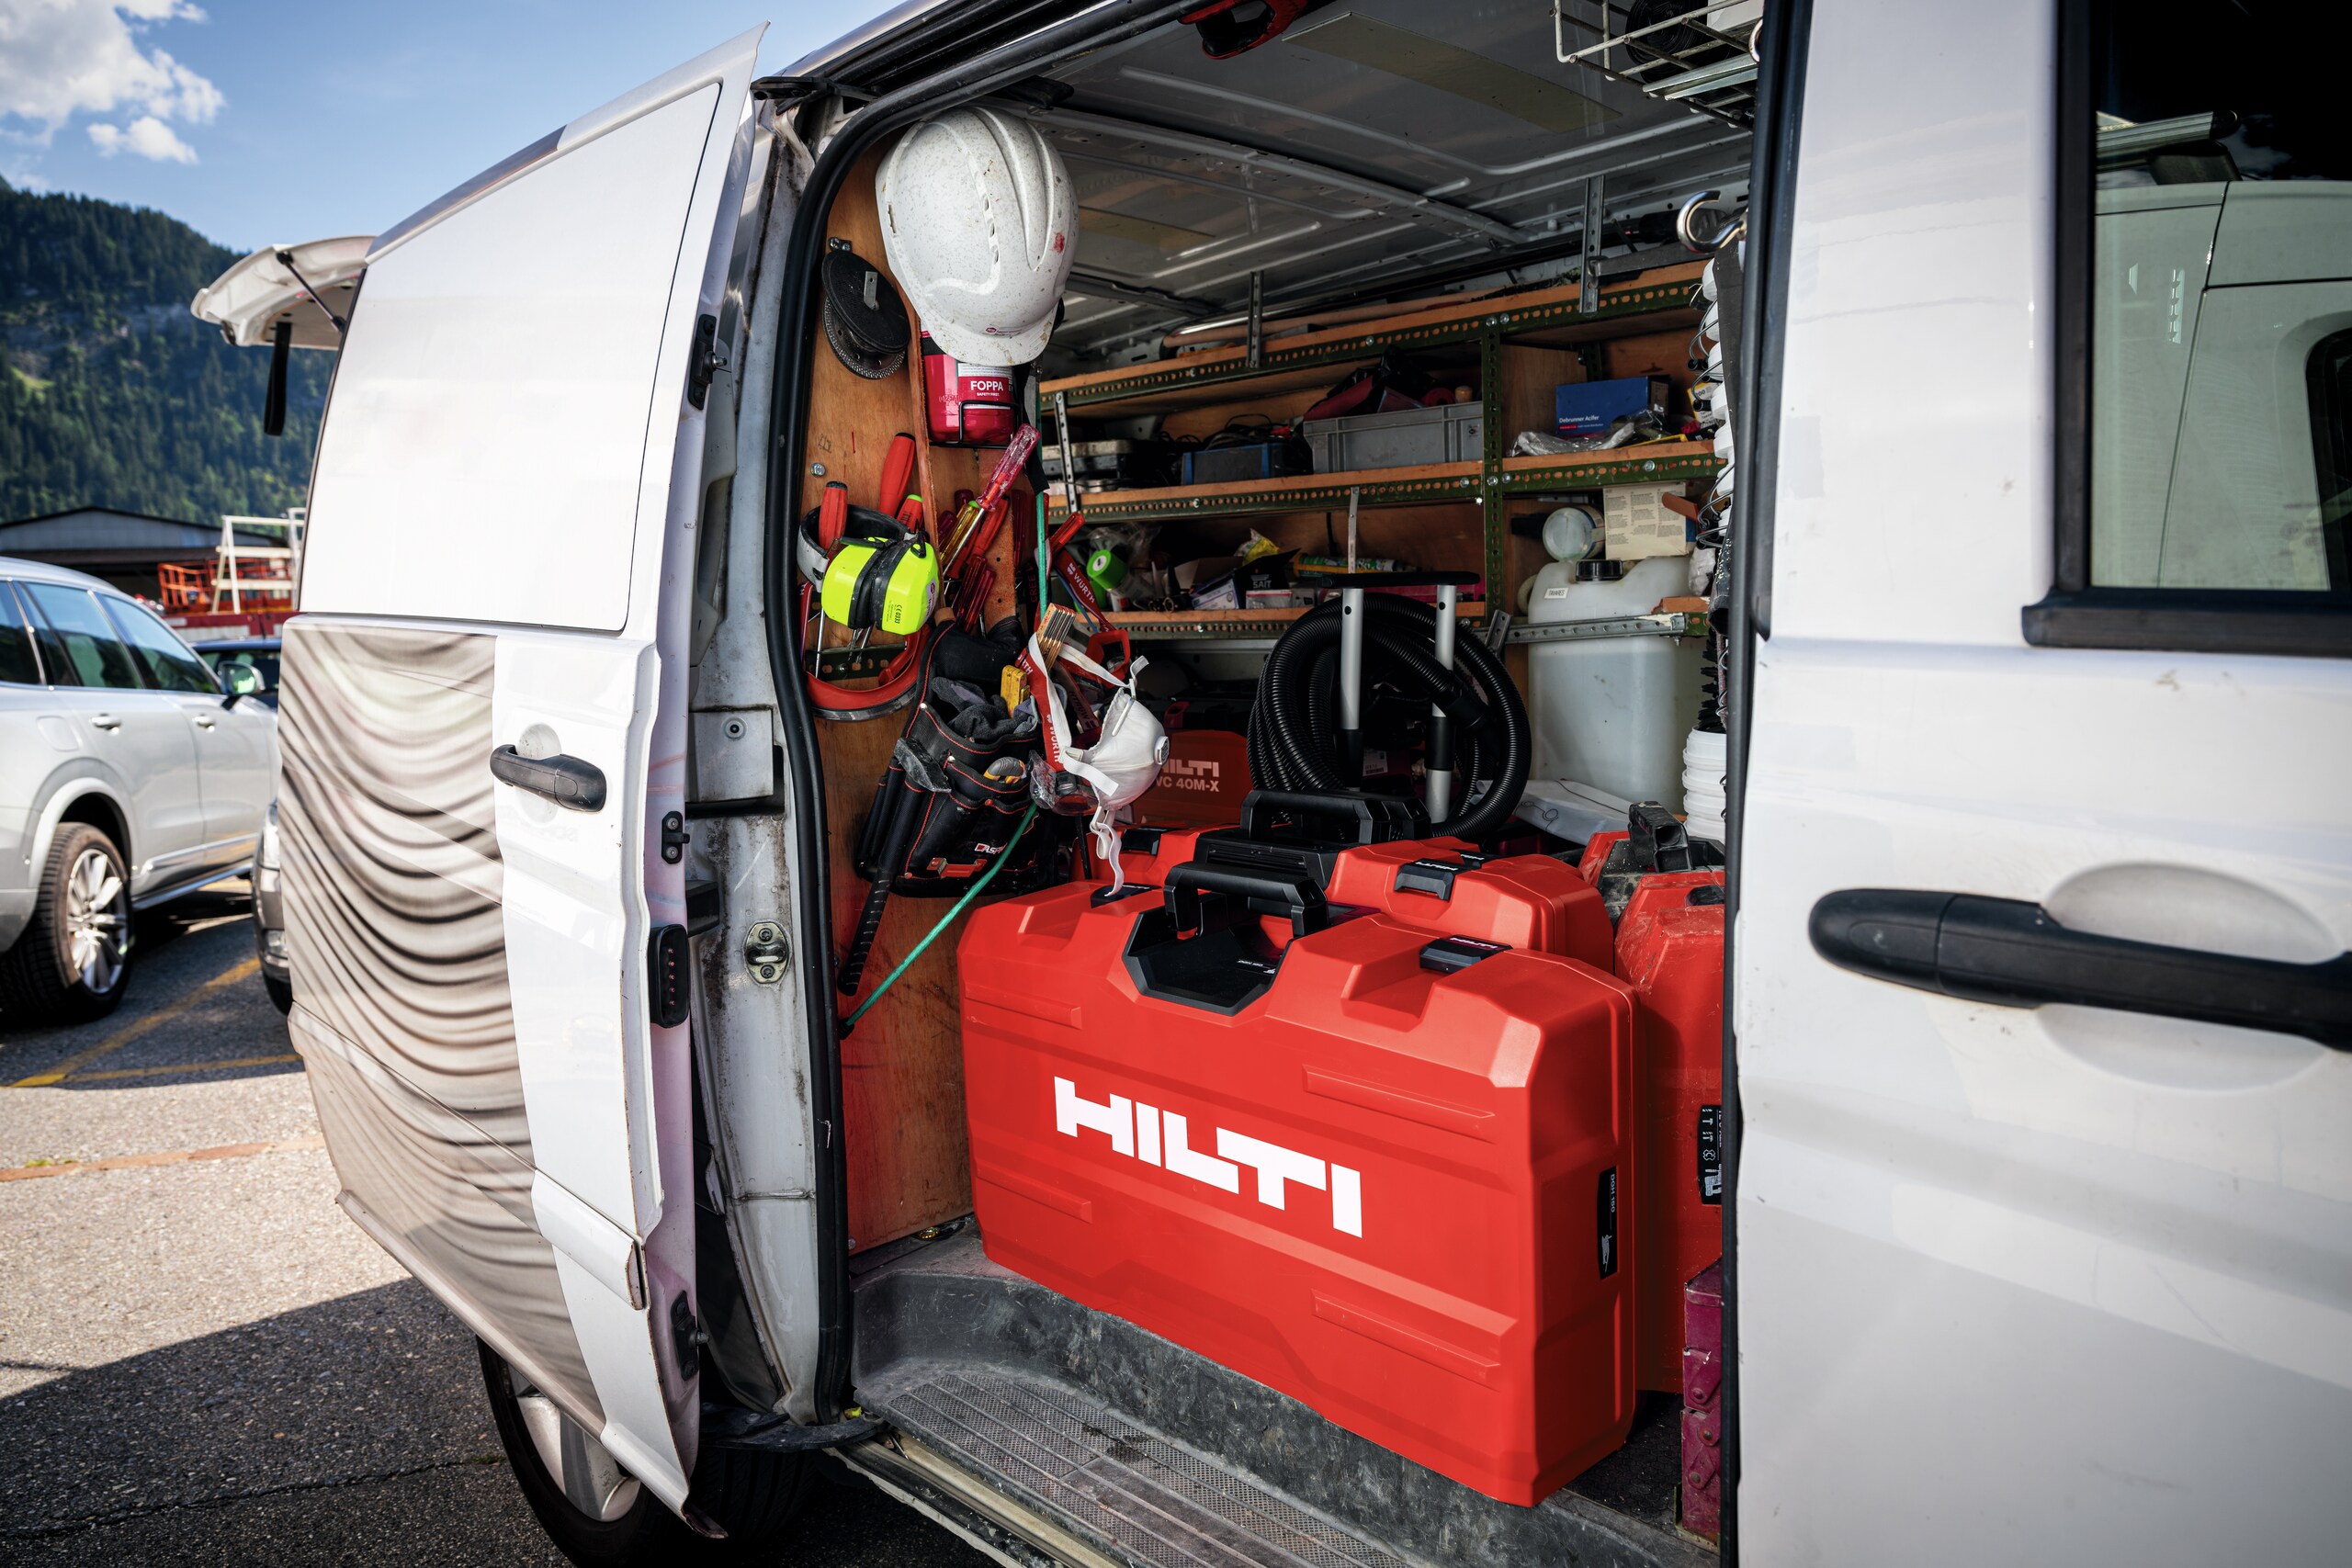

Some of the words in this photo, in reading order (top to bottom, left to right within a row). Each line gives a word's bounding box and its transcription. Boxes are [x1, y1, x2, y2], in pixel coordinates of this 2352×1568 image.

[970, 380, 1004, 391] FOPPA
[1176, 778, 1220, 793] 40M-X
[1054, 1076, 1363, 1238] HILTI
